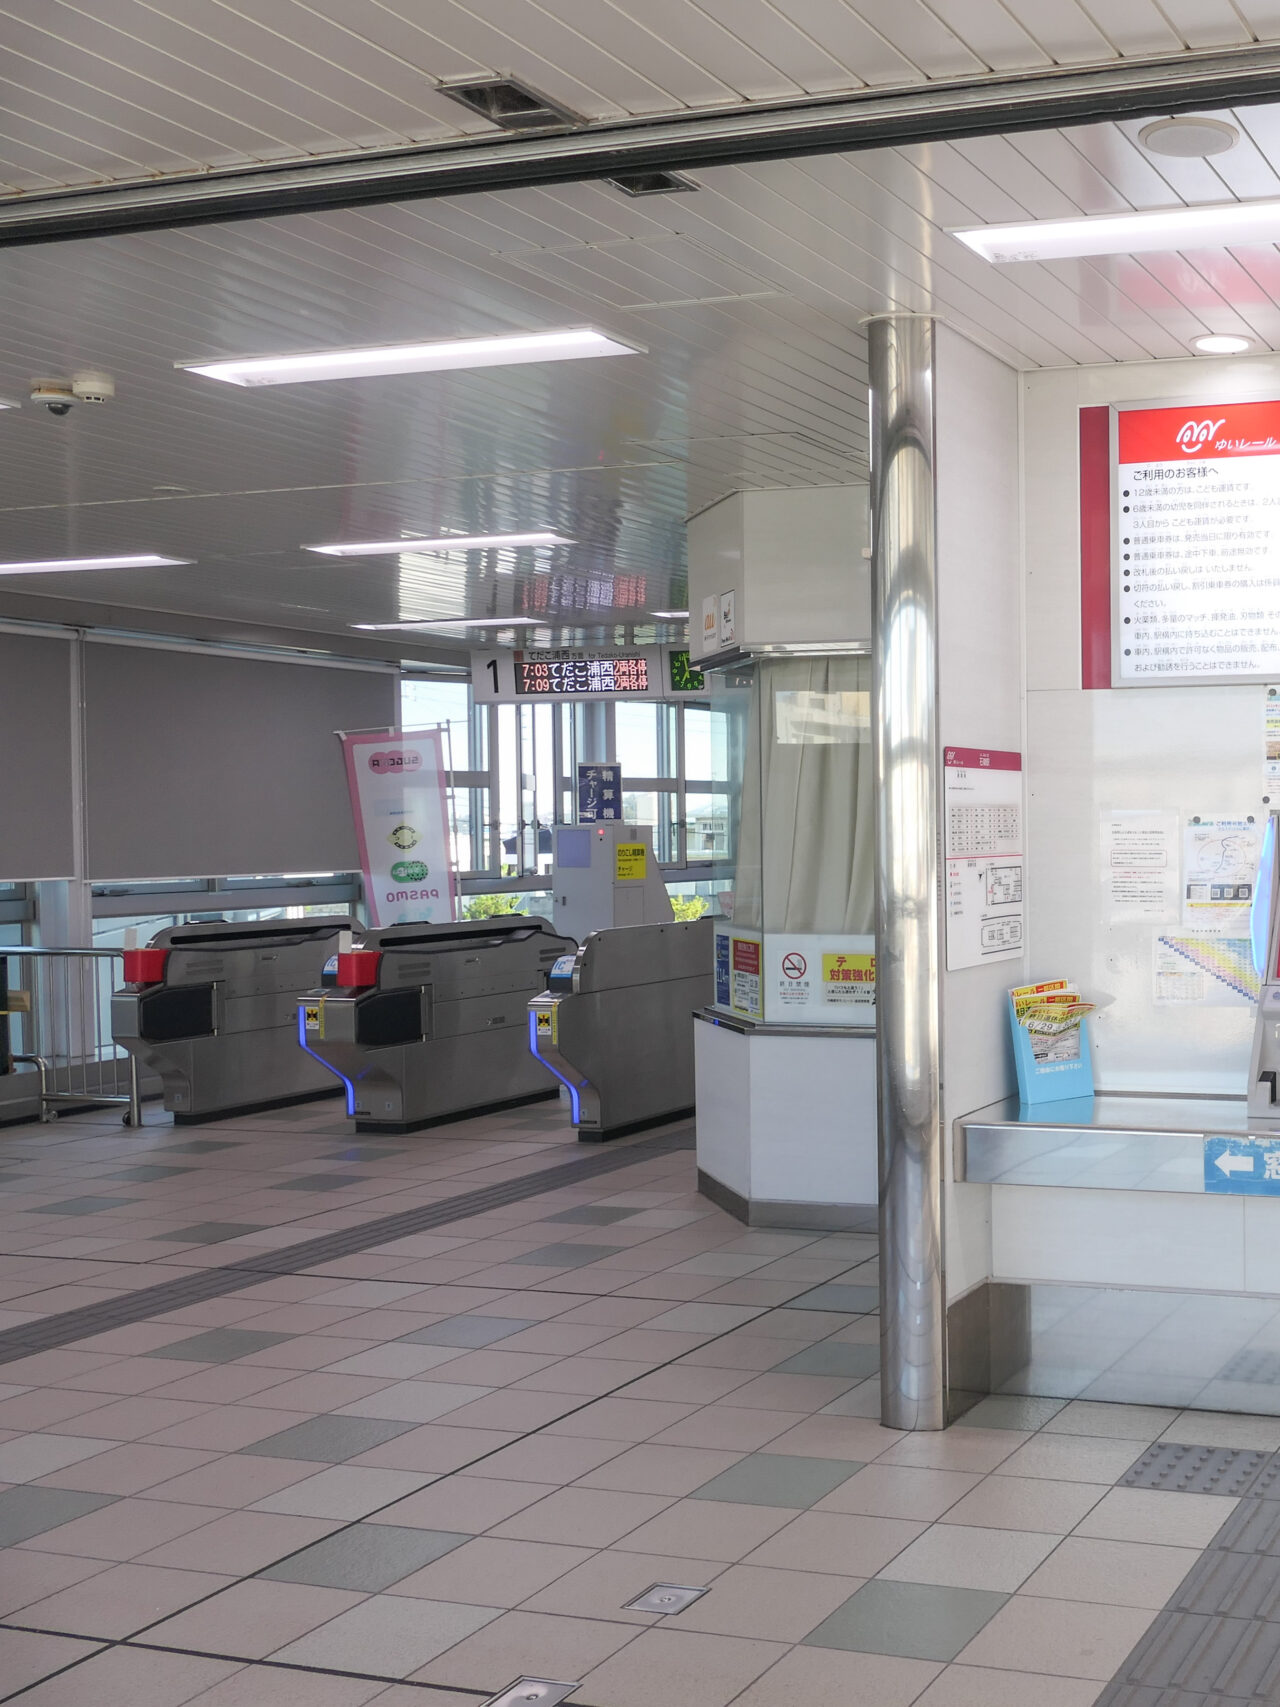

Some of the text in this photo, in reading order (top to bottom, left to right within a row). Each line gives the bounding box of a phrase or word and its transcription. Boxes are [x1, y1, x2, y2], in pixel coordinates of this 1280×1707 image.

[1214, 437, 1276, 449] ゆいレール
[1133, 467, 1218, 481] ご利用のお客様へ
[486, 659, 499, 693] 1
[602, 770, 615, 819] 精算機
[554, 960, 566, 971] IC
[830, 969, 875, 981] 対策強化
[1028, 1021, 1053, 1031] 6/29
